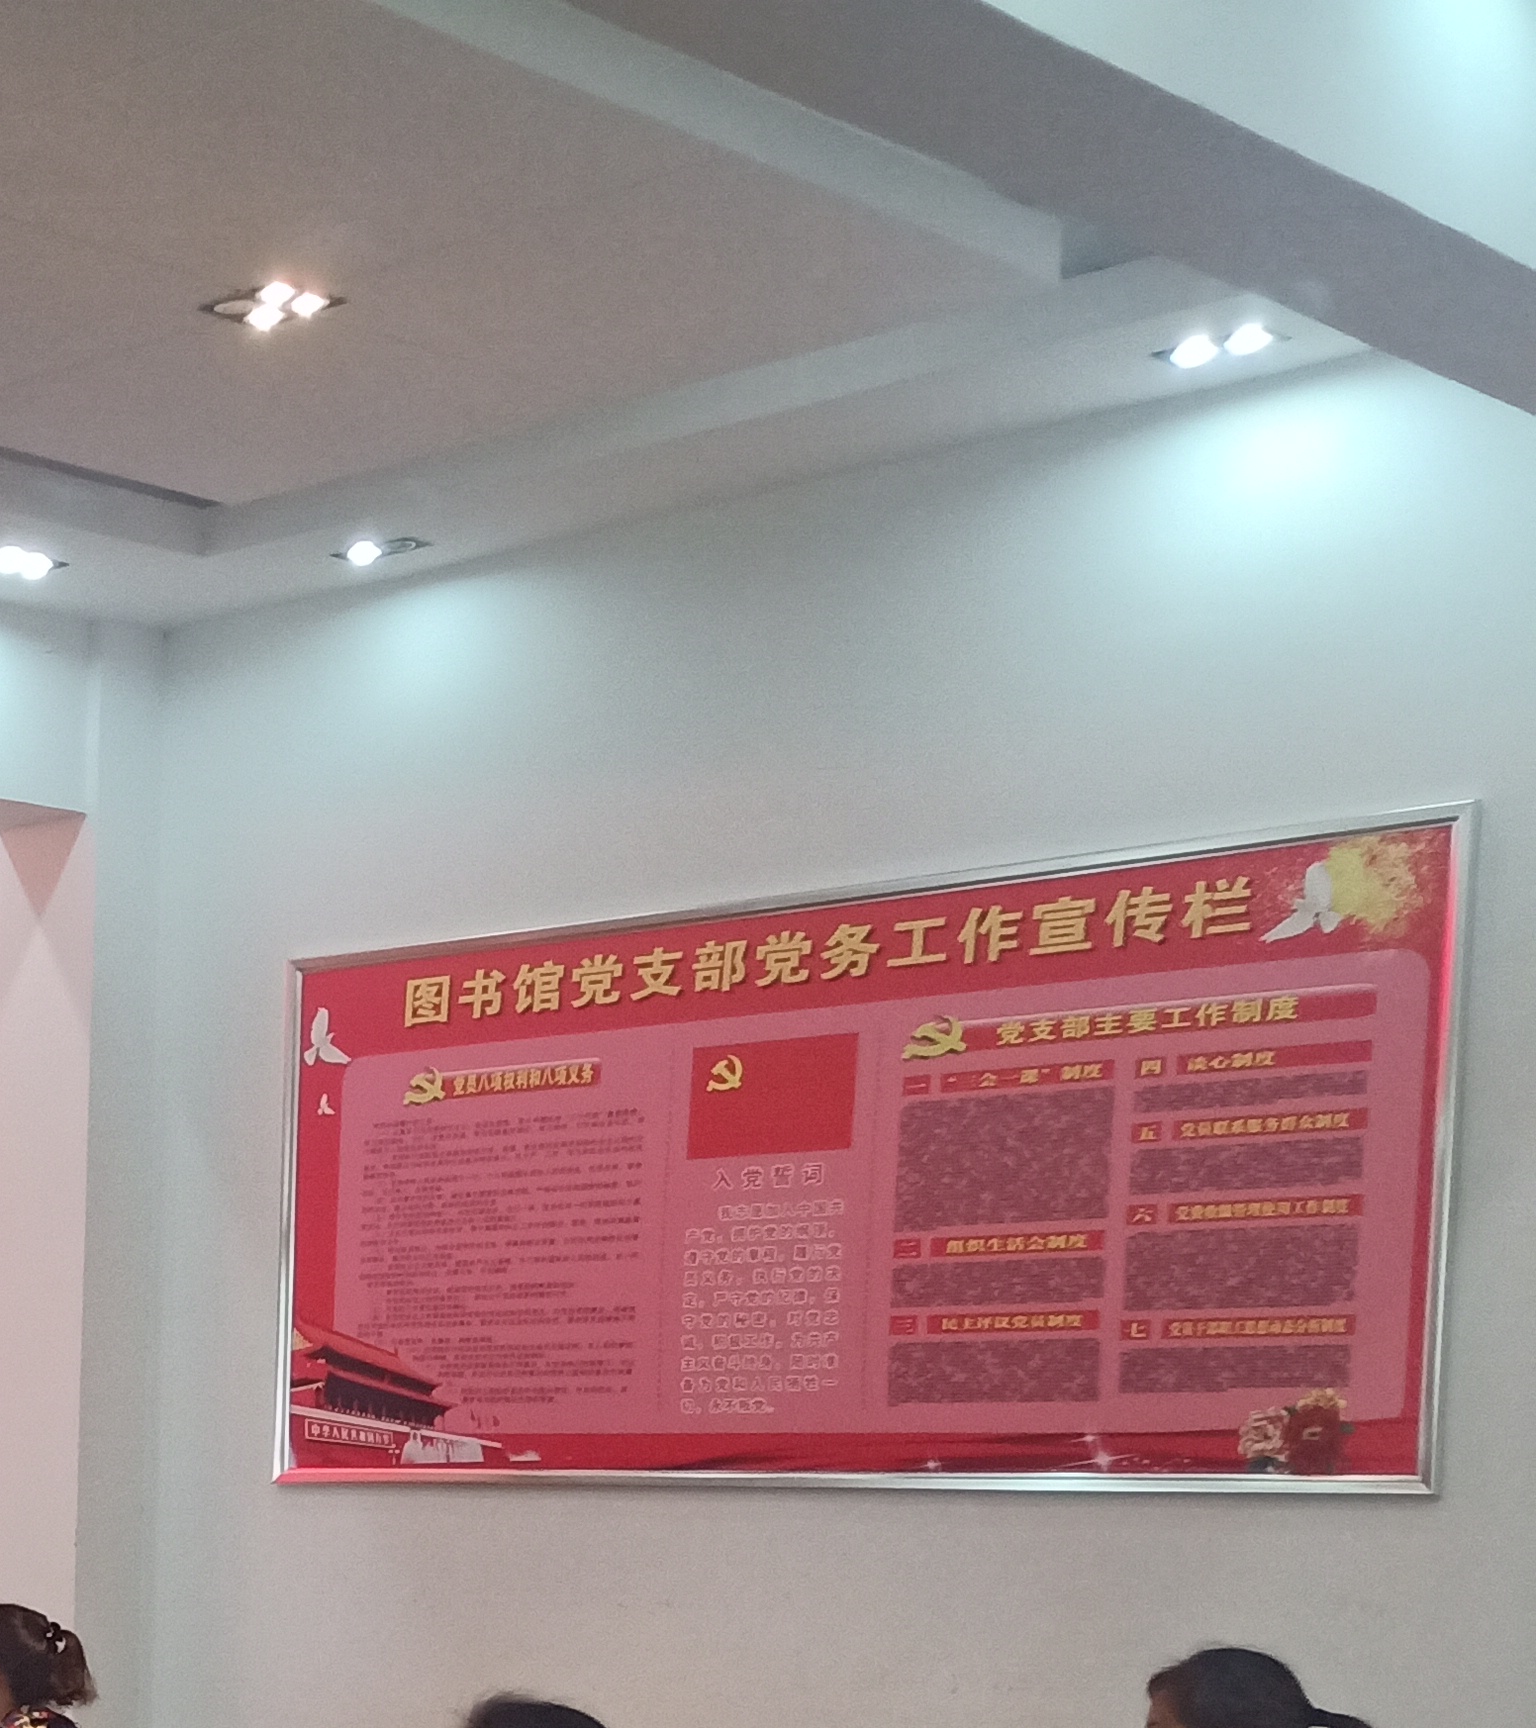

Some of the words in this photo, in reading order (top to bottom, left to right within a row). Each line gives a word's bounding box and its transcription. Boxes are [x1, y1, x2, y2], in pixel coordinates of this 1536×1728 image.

[403, 874, 1254, 1029] 图书馆党支部党务工作宣传栏
[995, 996, 1299, 1047] 党支部主要工作制度
[452, 1063, 594, 1097] 党员八项权利和八项义务
[712, 1162, 824, 1190] 入党誓词
